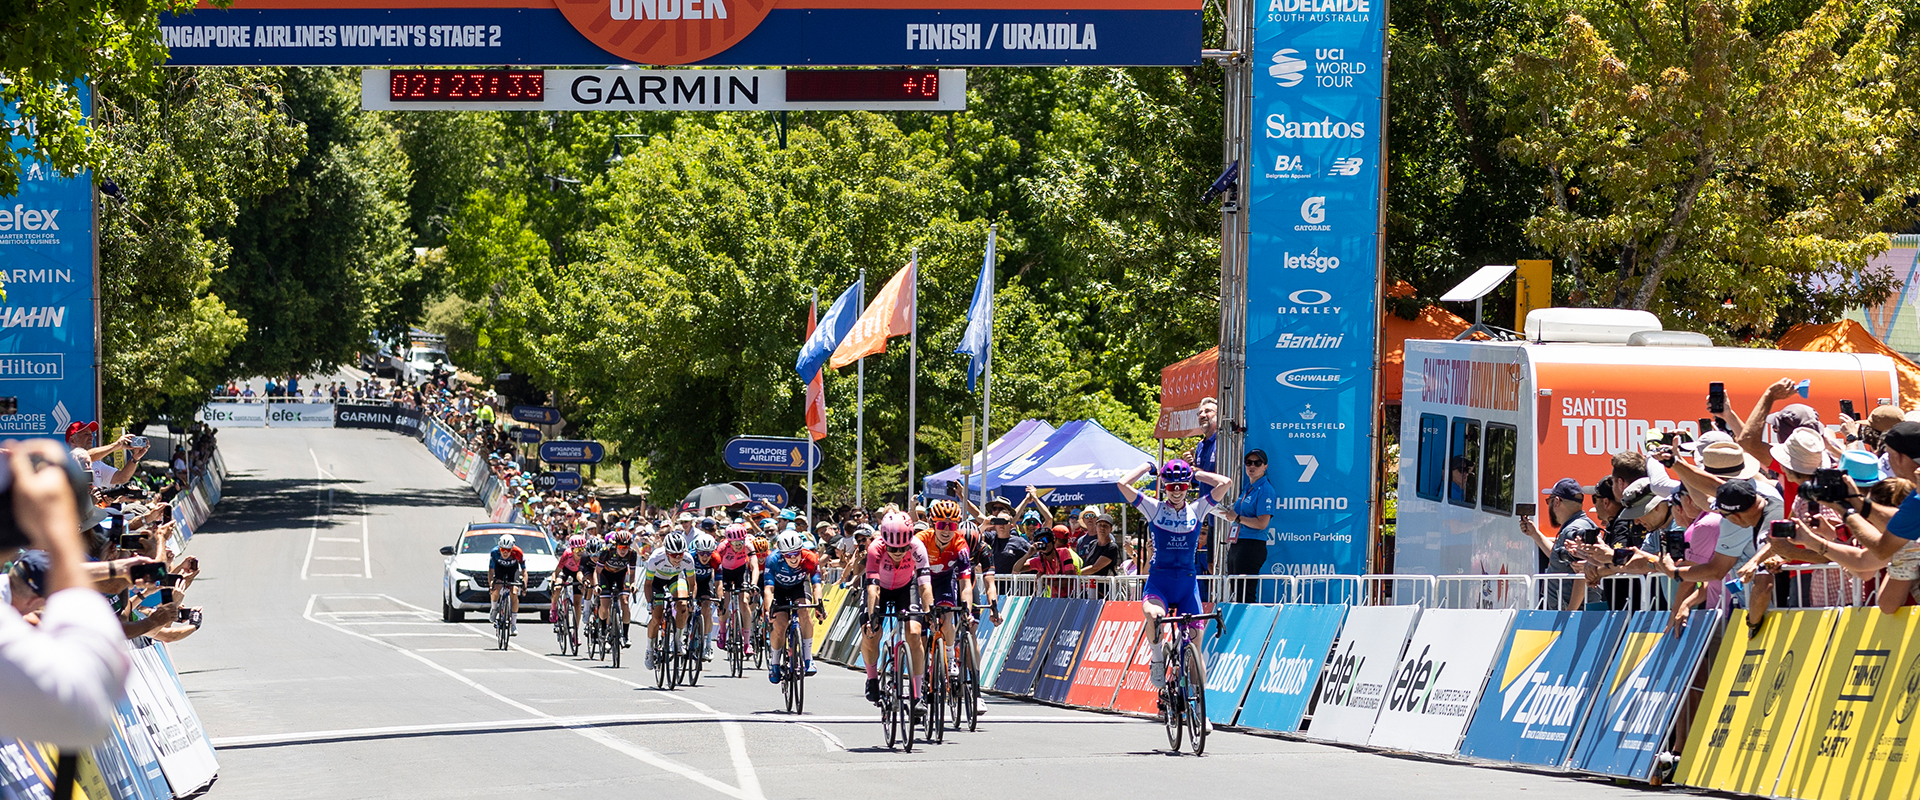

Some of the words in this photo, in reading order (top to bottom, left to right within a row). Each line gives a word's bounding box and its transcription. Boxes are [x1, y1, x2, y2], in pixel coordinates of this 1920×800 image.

[1268, 0, 1370, 12] ADELAIDE
[1268, 13, 1305, 22] SOUTH
[1310, 13, 1370, 22] AUSTRALIA
[162, 25, 251, 47] INGAPORE
[254, 25, 337, 47] AIRLINES
[340, 25, 426, 47] WOMEN'S
[430, 25, 486, 47] STAGE
[488, 25, 501, 47] 2
[906, 23, 981, 50] FINISH
[984, 23, 999, 50] /
[1002, 23, 1097, 50] URAIDLA
[1315, 48, 1344, 61] UCI
[1315, 62, 1367, 75] WORLD
[391, 73, 543, 98] 02:23:33
[570, 74, 759, 105] GARMIN
[1315, 75, 1354, 88] TOUR
[1266, 113, 1365, 139] Santos
[0, 203, 60, 231] efex
[1283, 251, 1341, 274] letsgo
[0, 306, 66, 328] HAHN
[1277, 306, 1342, 315] OAKLEY
[1275, 333, 1345, 349] Santini
[0, 359, 58, 375] Hilton
[1286, 374, 1342, 382] SCHWALBE
[1422, 357, 1451, 404] SANTOS
[1450, 359, 1470, 406] TOUR
[1470, 361, 1495, 410] DOWN
[1493, 362, 1521, 412] UNDER
[203, 409, 234, 422] efex
[271, 409, 302, 422] efex
[1561, 396, 1628, 418] SANTOS
[339, 411, 391, 423] GARMIN
[0, 422, 47, 431] AIRLINES
[1270, 422, 1346, 430] SEPPELTSFIELD
[1561, 418, 1650, 456] TOUR
[739, 446, 787, 456] SINGAPORE
[749, 454, 787, 463] AIRLINES
[539, 476, 556, 485] 100
[1051, 492, 1084, 503] Ziptrak
[1275, 497, 1348, 510] HIMANO
[1157, 516, 1197, 528] Jayco
[1277, 532, 1312, 541] Wilson
[1313, 532, 1352, 544] Parking
[1286, 563, 1336, 576] YAMAHA
[1020, 626, 1045, 643] SINGAPORE
[1056, 629, 1081, 647] SINGAPORE
[1083, 620, 1143, 664] ADELAIDE
[1014, 644, 1037, 661] AIRLINES
[1052, 650, 1074, 668] AIRLINES
[1258, 638, 1314, 695] Santos
[1322, 640, 1366, 707] efex
[1074, 666, 1097, 685] SOUTH
[1091, 668, 1122, 687] AUSTRALIA
[1389, 644, 1447, 714] efex
[1848, 665, 1881, 686] THINK!
[1512, 670, 1588, 739] Ziptrak
[1826, 709, 1854, 731] ROAD
[1817, 736, 1852, 758] SAFETY
